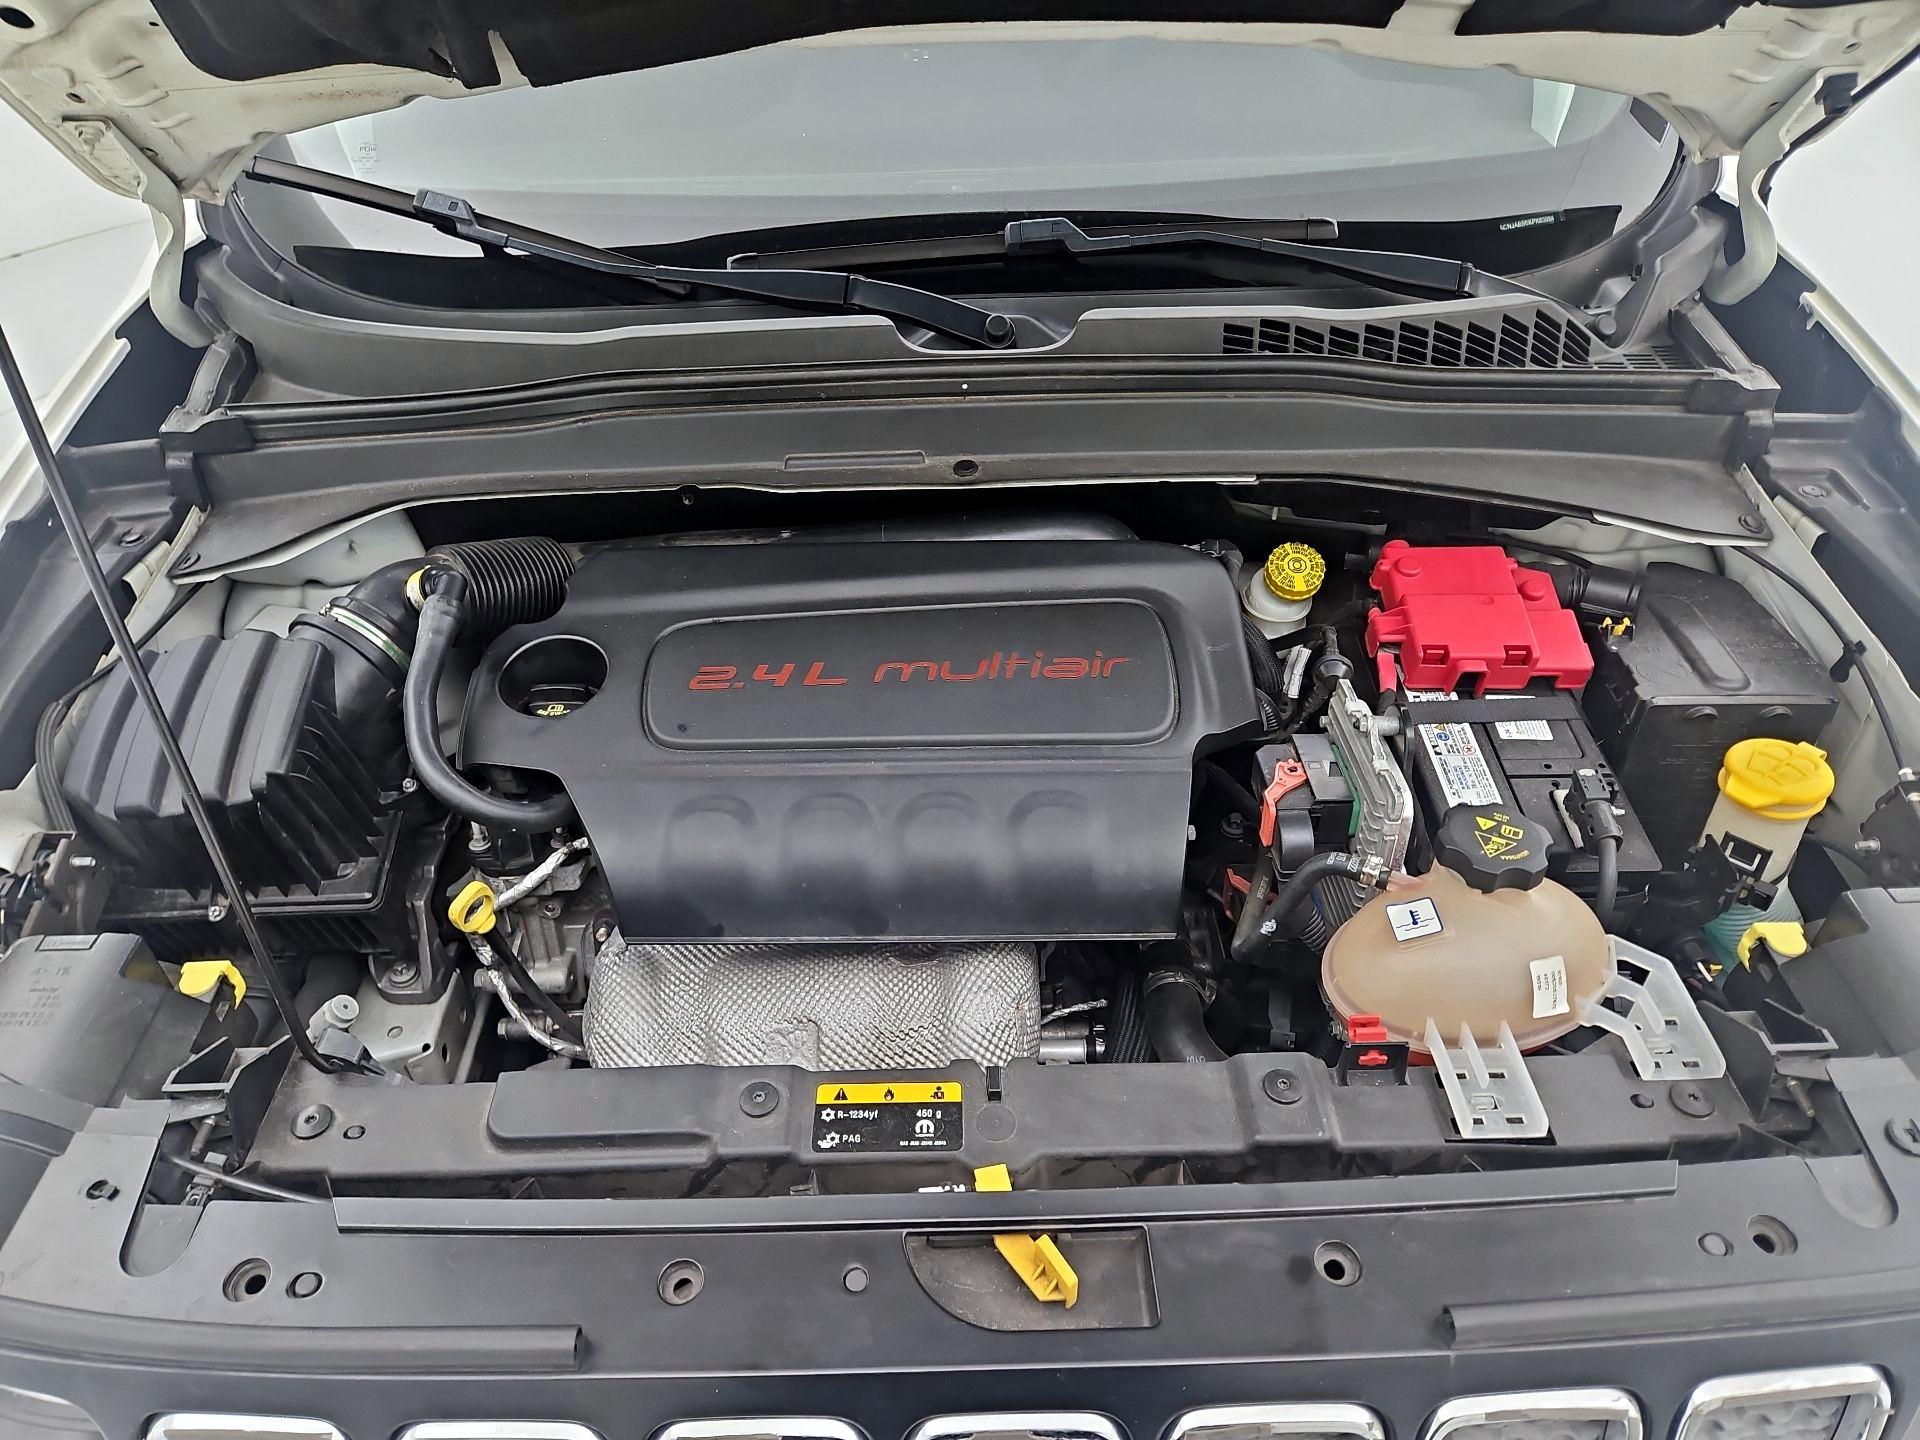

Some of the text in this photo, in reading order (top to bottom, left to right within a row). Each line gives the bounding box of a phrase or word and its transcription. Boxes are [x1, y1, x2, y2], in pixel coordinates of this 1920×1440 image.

[872, 650, 1131, 683] multiair
[837, 1110, 879, 1120] R-1234yf
[936, 1110, 942, 1119] g
[842, 1134, 861, 1143] PAG
